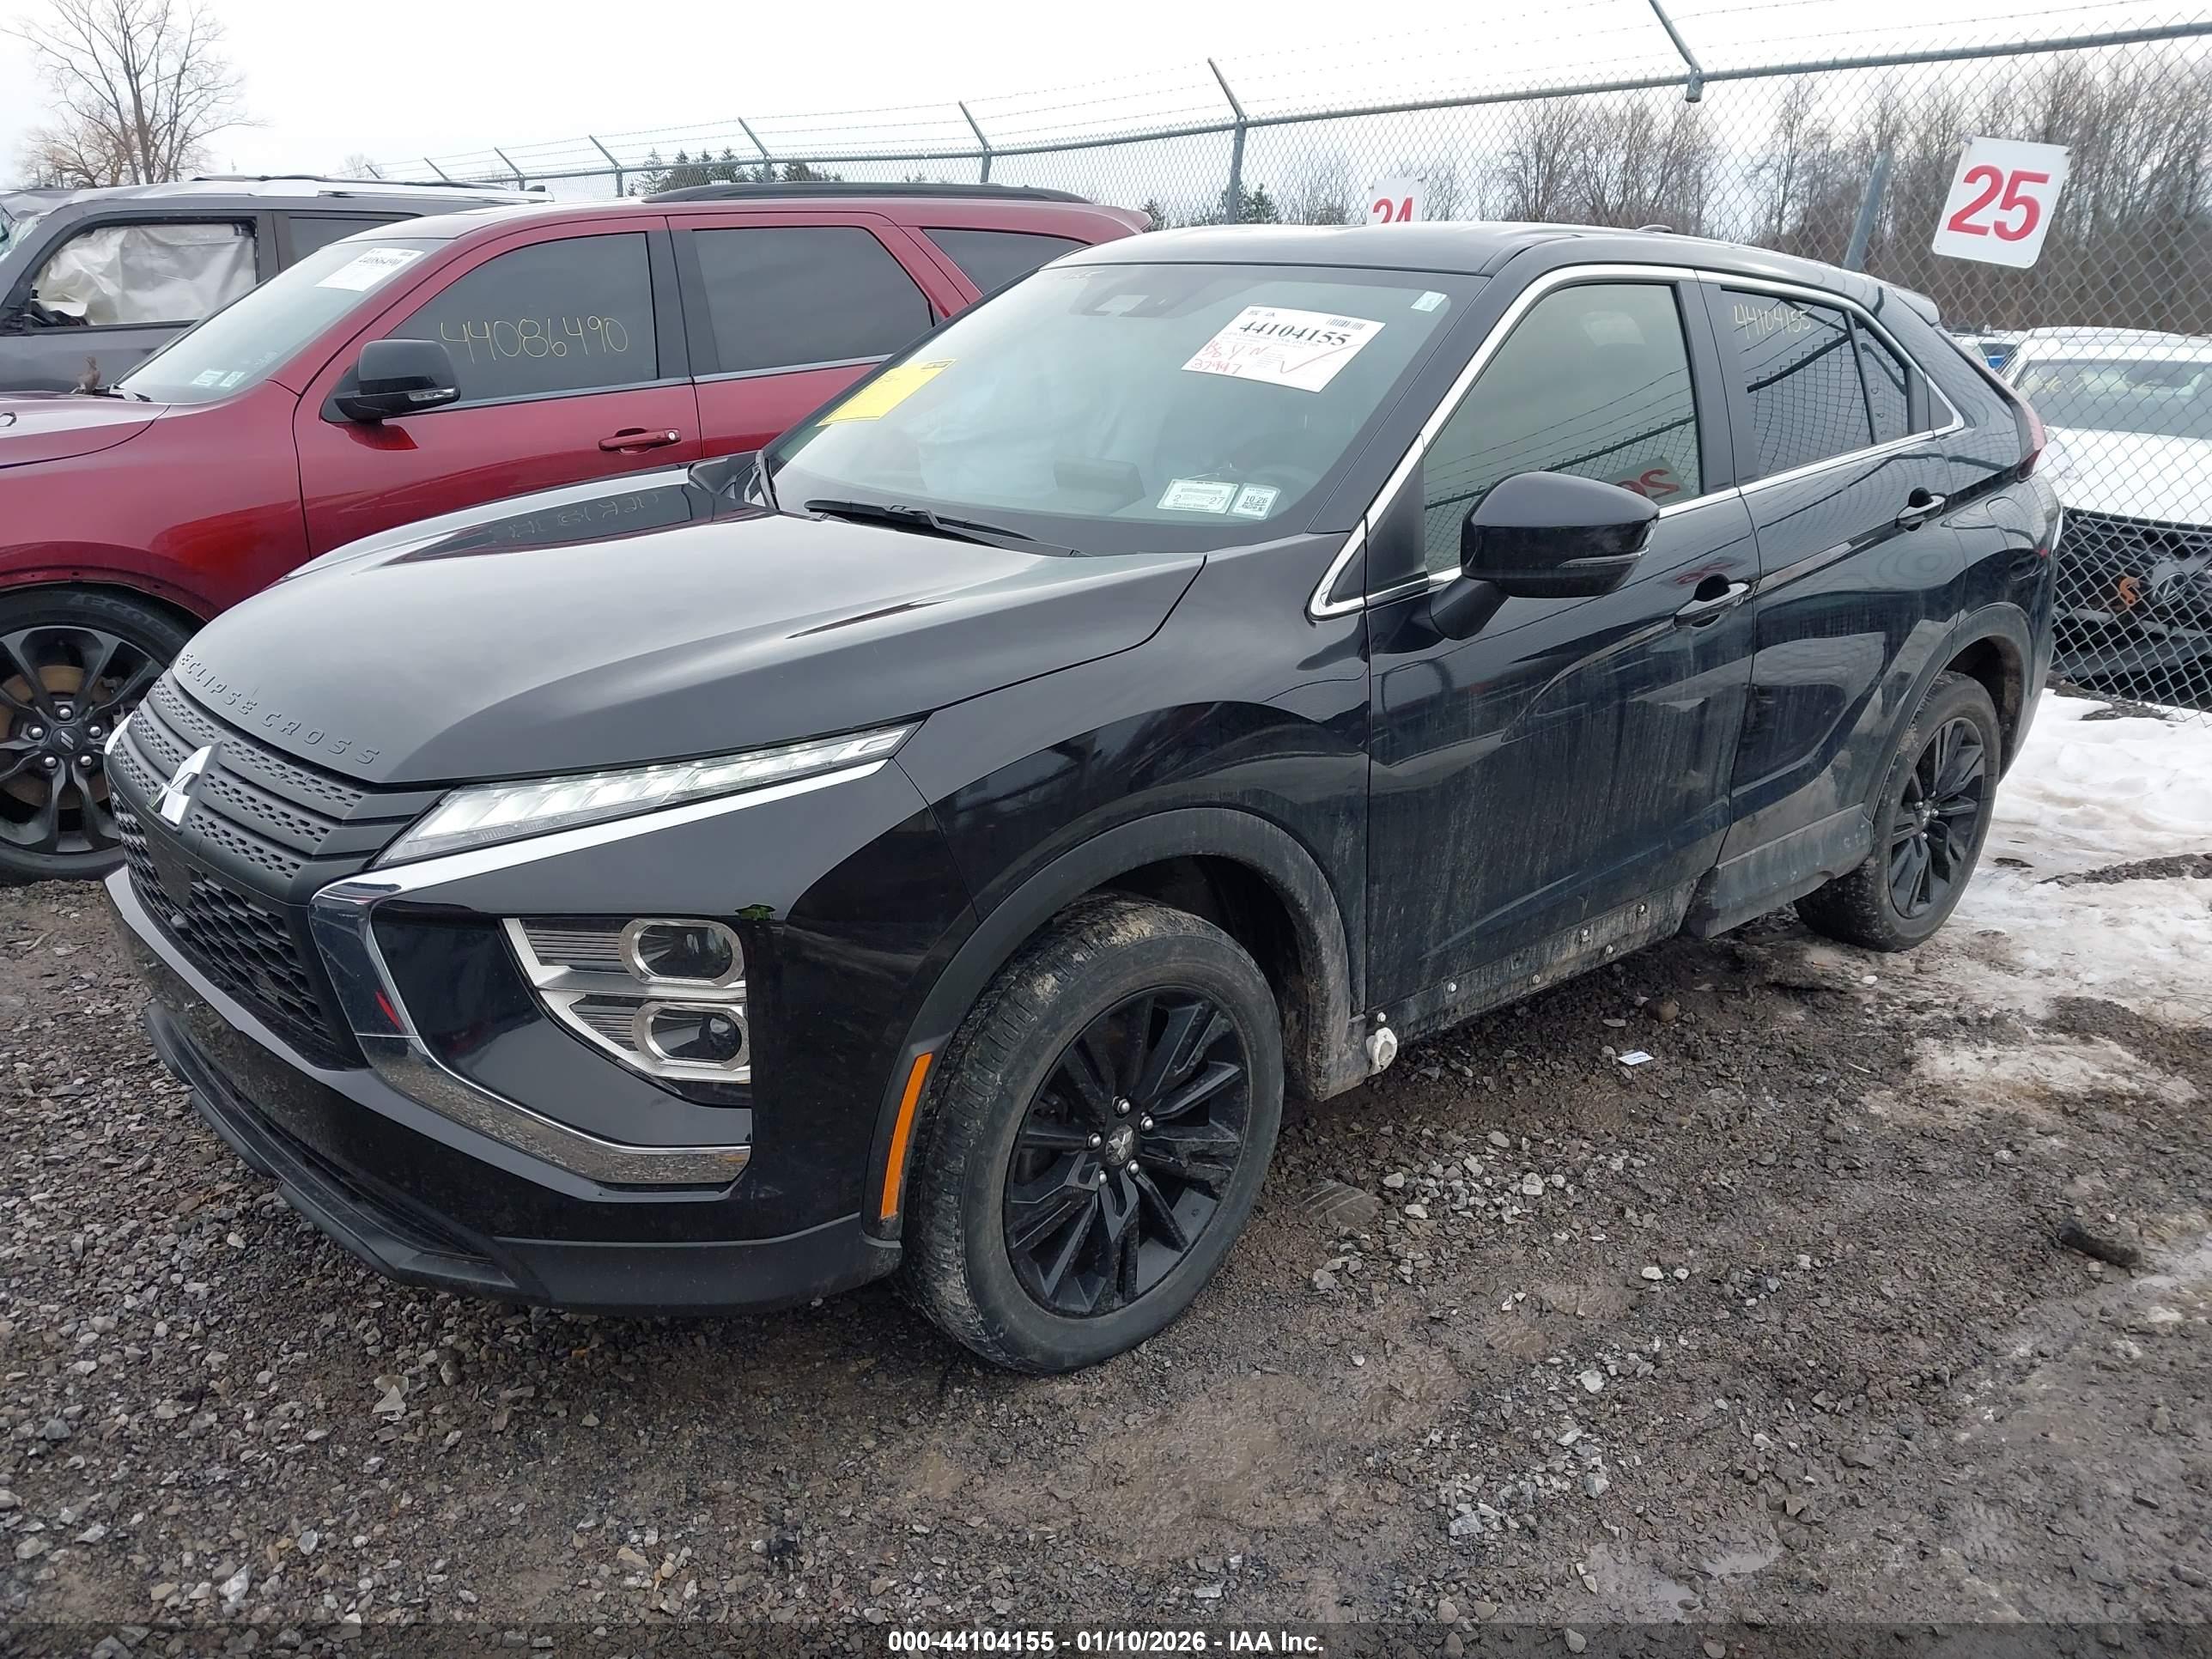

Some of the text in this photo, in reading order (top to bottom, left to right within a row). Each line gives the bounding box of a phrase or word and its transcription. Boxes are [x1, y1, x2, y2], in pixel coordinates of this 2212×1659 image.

[1947, 164, 2051, 242] 25
[440, 314, 629, 365] 44086490
[1238, 320, 1352, 347] 44104155
[1733, 302, 1812, 340] 44104155
[179, 653, 380, 765] ECLIPSE CROSS
